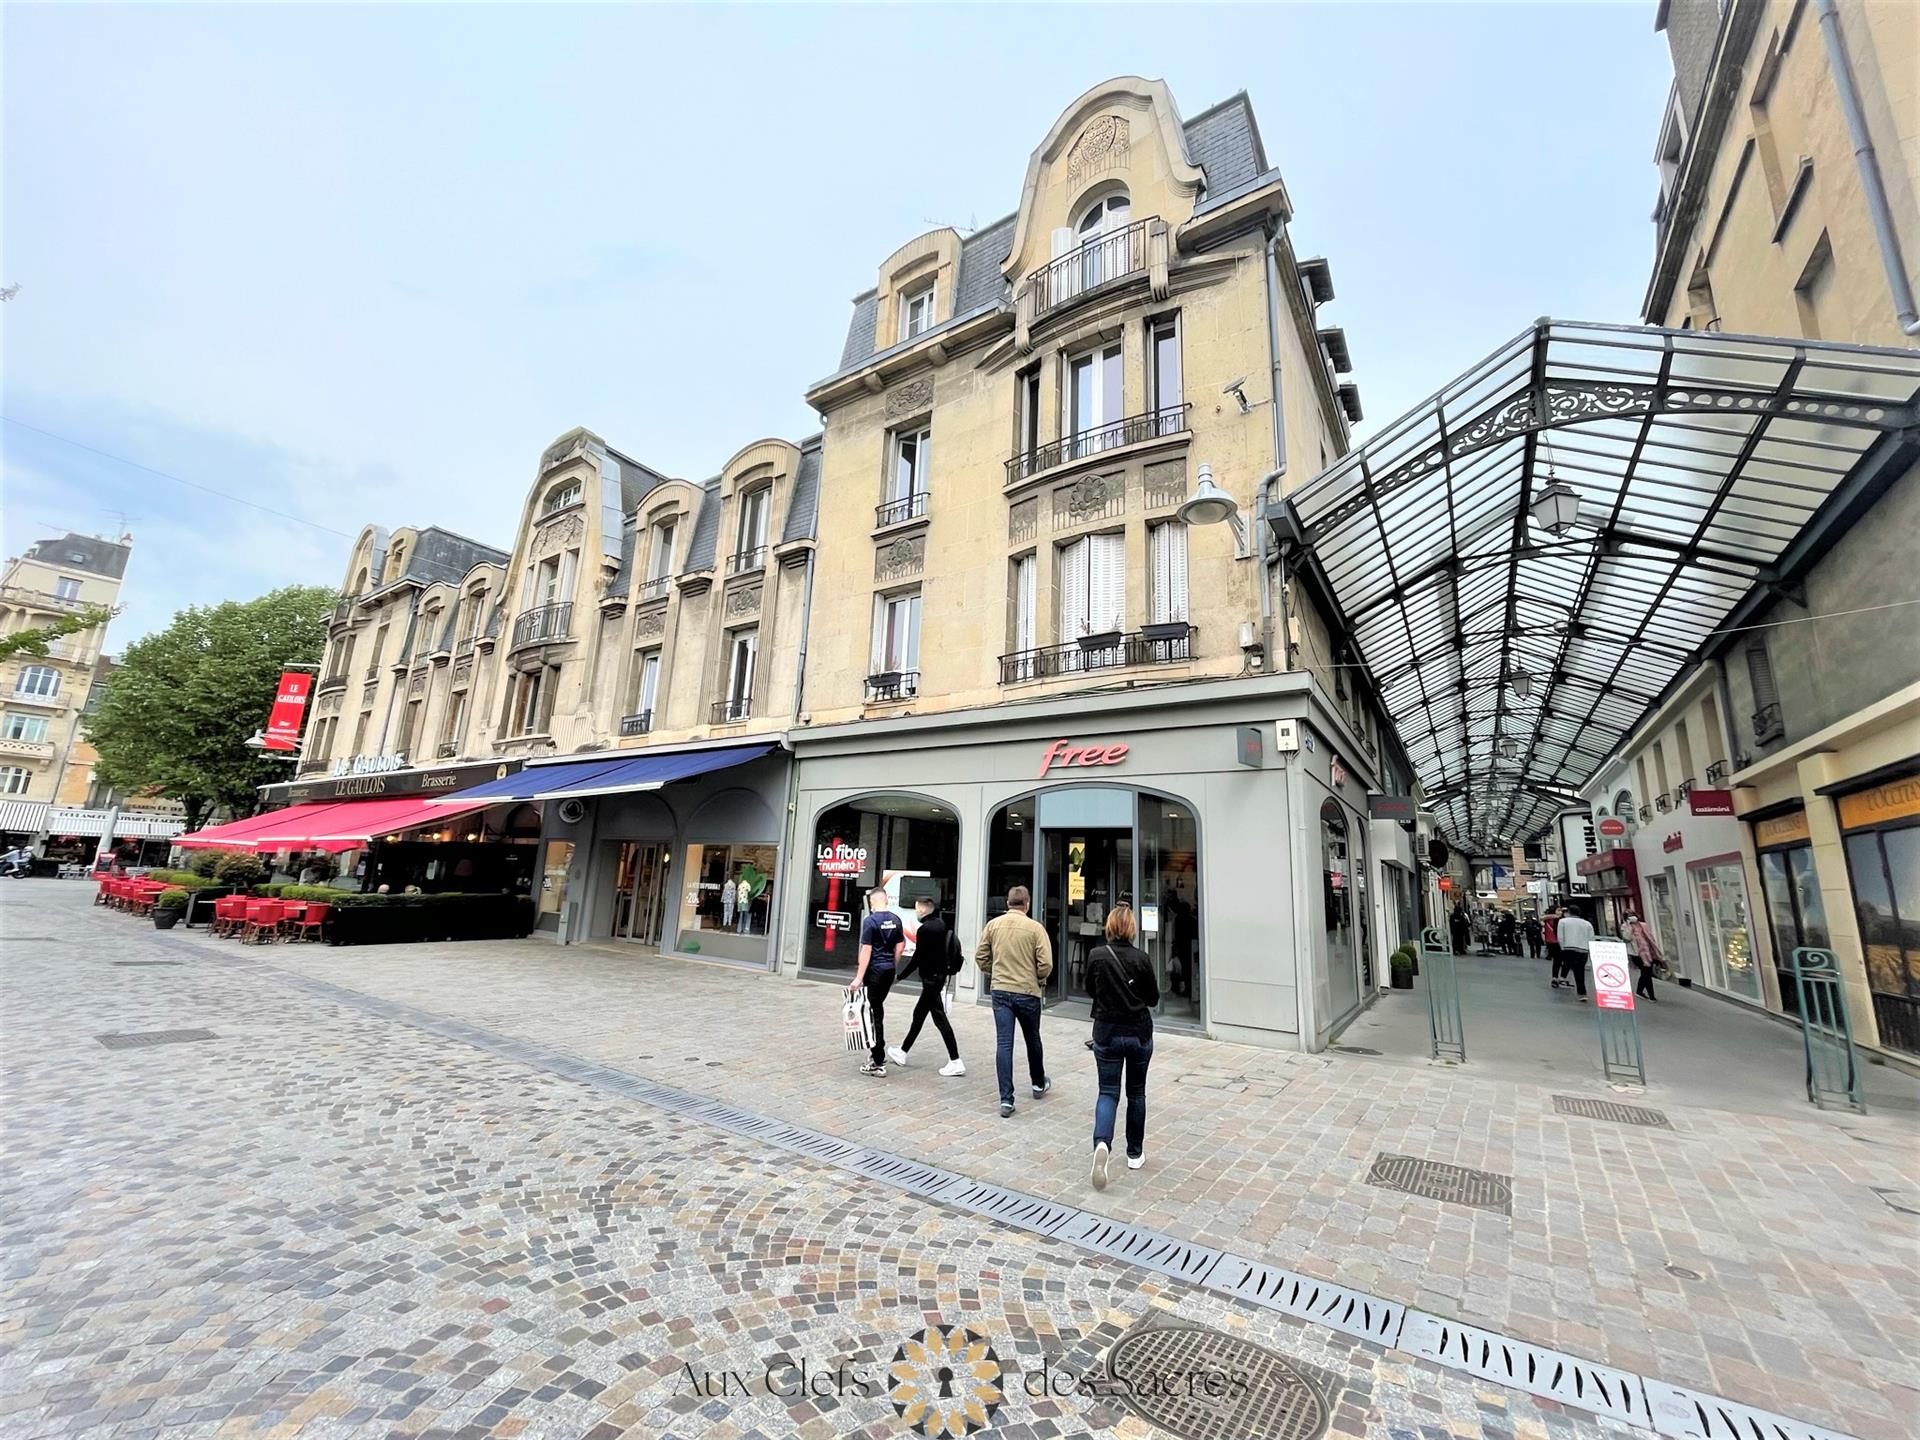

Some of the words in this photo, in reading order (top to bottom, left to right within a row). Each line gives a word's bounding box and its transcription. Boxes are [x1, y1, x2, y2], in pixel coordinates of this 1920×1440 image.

[289, 684, 299, 693] LE
[1040, 739, 1129, 777] free
[335, 779, 347, 796] LE
[347, 776, 386, 795] GAULOIS
[421, 771, 457, 788] Brasserie
[817, 844, 832, 859] La
[835, 844, 868, 860] fibre
[822, 861, 855, 872] numéro
